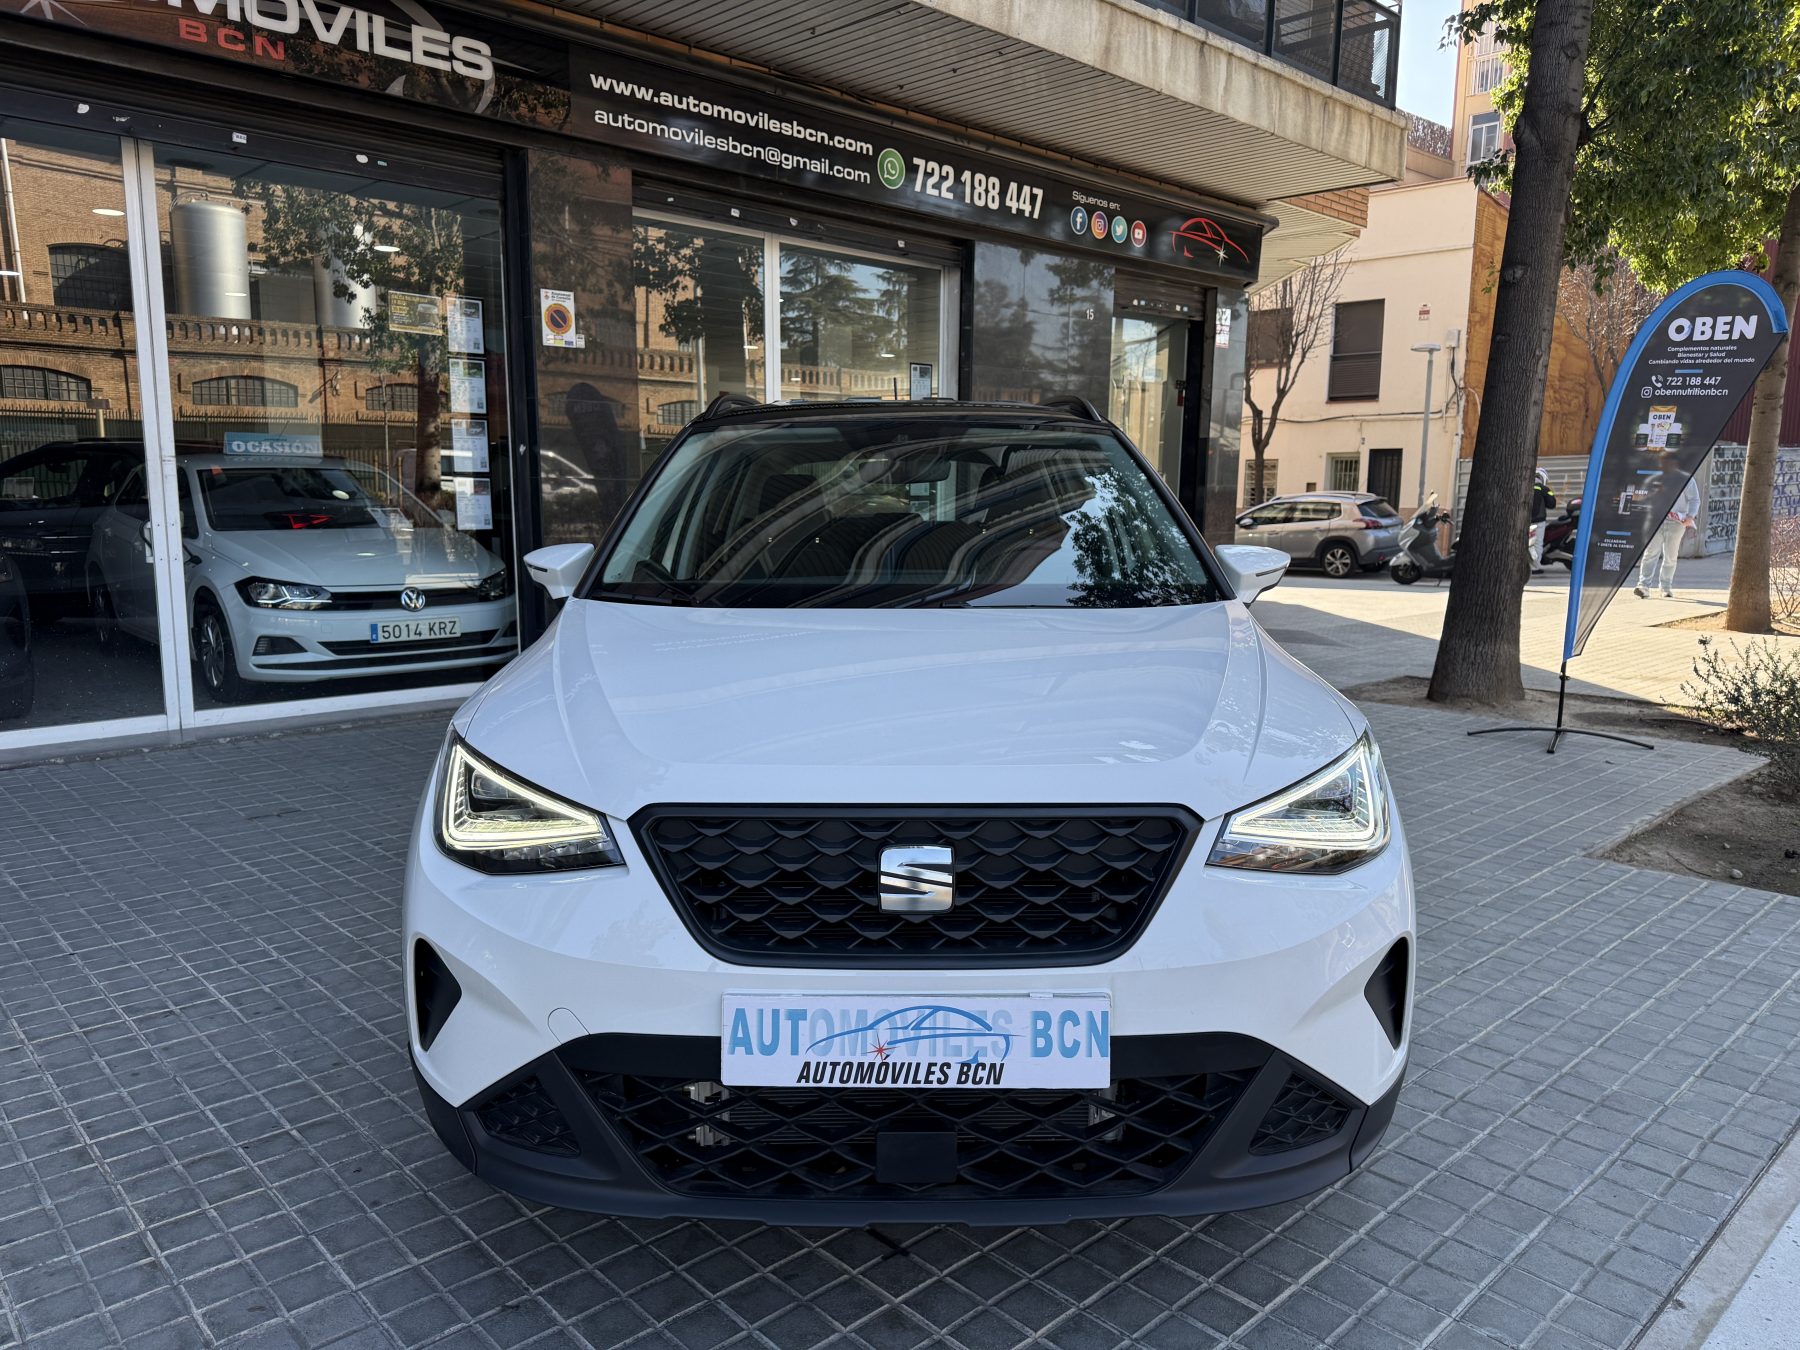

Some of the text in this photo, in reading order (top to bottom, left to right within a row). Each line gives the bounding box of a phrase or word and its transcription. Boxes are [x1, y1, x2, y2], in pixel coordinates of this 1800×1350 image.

[179, 18, 285, 61] BCN
[589, 73, 873, 156] www.automovilesbcn.com
[594, 109, 870, 184] automovilesbcn@gmail.com
[912, 157, 1044, 219] 722 188 447
[1072, 190, 1108, 208] Síguenos
[1086, 308, 1095, 321] 15
[1668, 315, 1758, 342] OBEN
[1654, 387, 1729, 396] obennutritionbcn
[1666, 376, 1722, 386] 722 188 447
[381, 623, 423, 640] 5014
[428, 620, 457, 637] KRZ
[727, 1007, 1109, 1059] AUTOMOVILES BCN
[956, 1062, 1005, 1086] BCN
